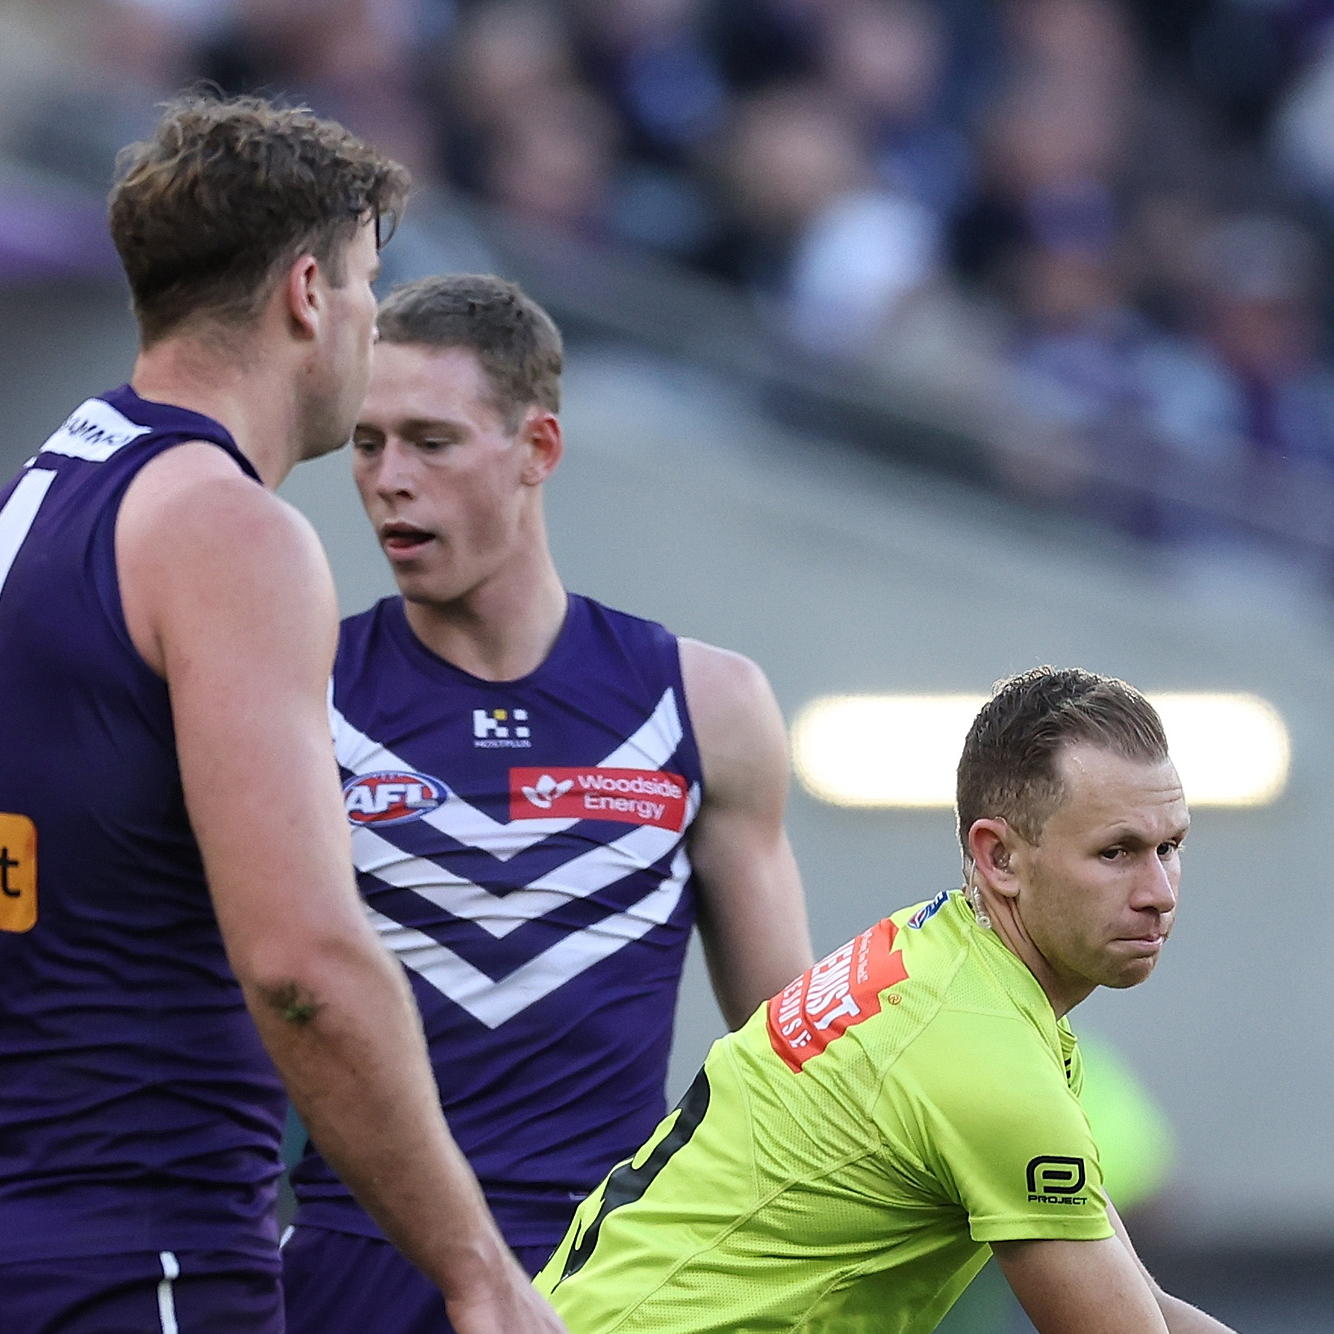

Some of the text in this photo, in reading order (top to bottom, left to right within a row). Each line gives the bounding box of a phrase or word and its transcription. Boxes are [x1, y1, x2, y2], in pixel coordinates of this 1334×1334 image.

[345, 782, 439, 815] AFL
[578, 774, 683, 799] Woodside
[583, 792, 666, 821] Energy
[1028, 1194, 1088, 1206] PROJECT
